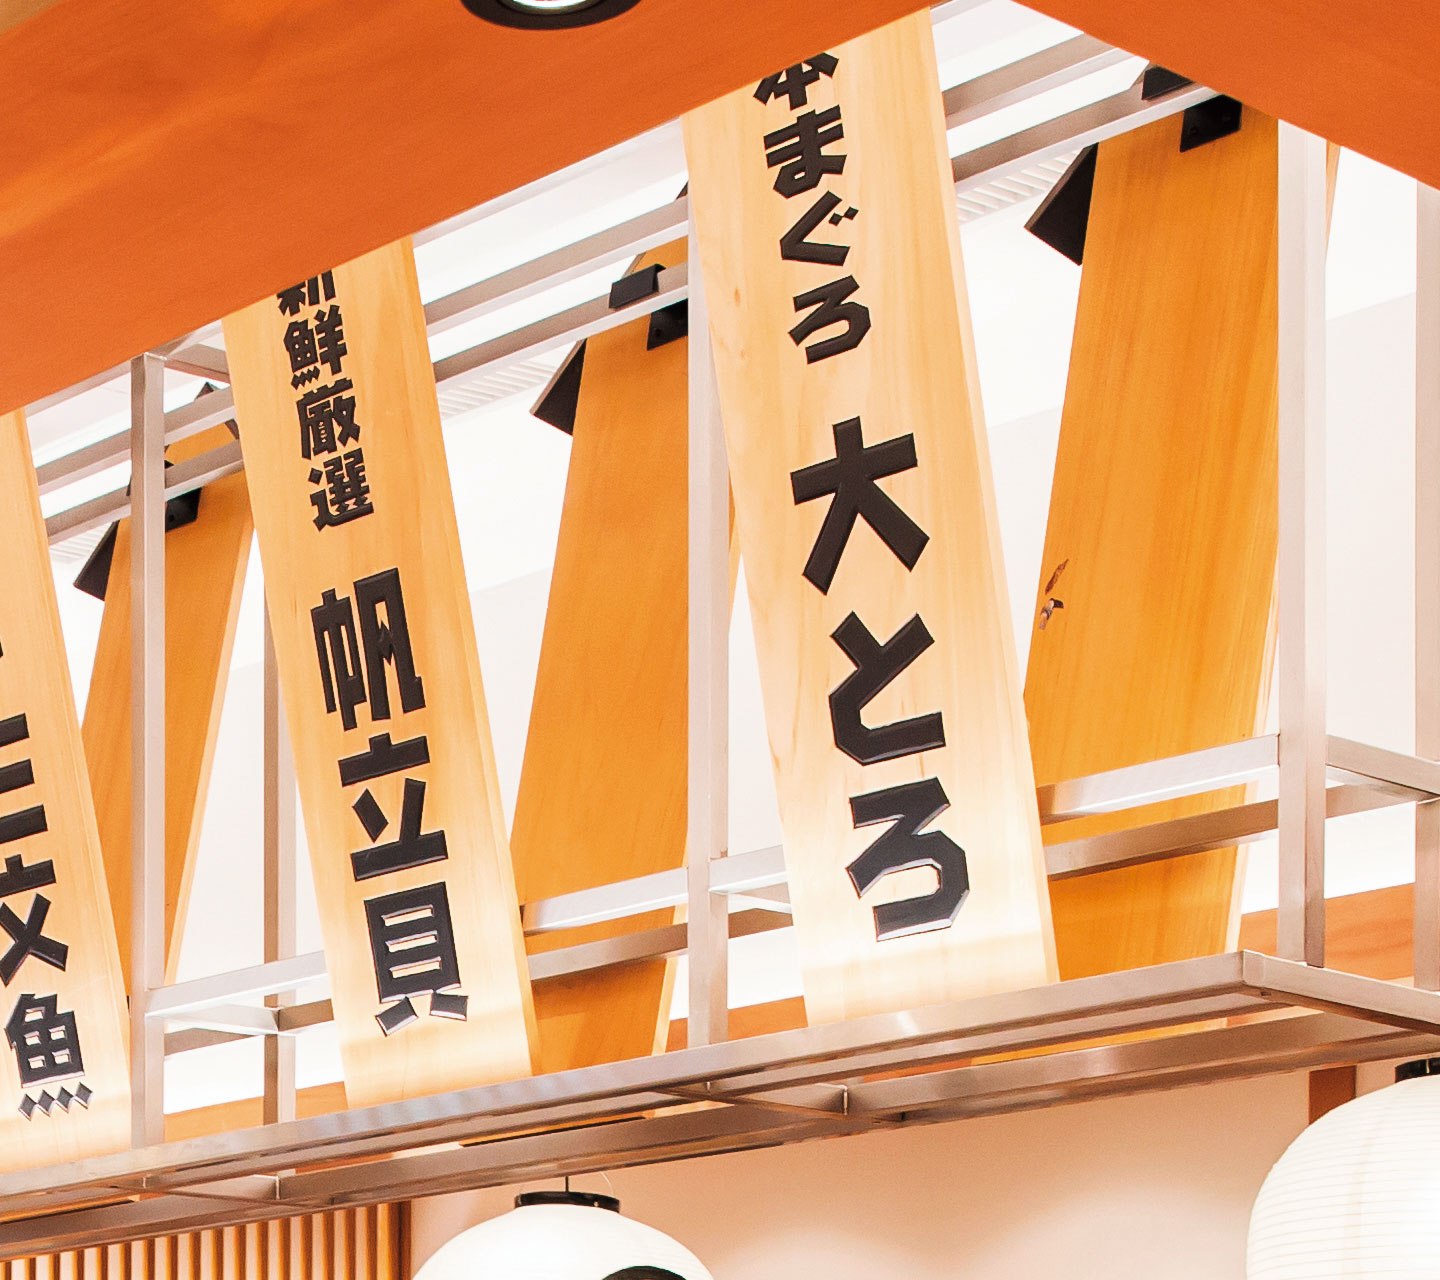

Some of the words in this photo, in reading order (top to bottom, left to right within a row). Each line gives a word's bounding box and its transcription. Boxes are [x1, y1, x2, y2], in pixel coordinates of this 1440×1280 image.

[310, 565, 469, 1039] 帆立貝
[790, 414, 971, 943] 大とろ
